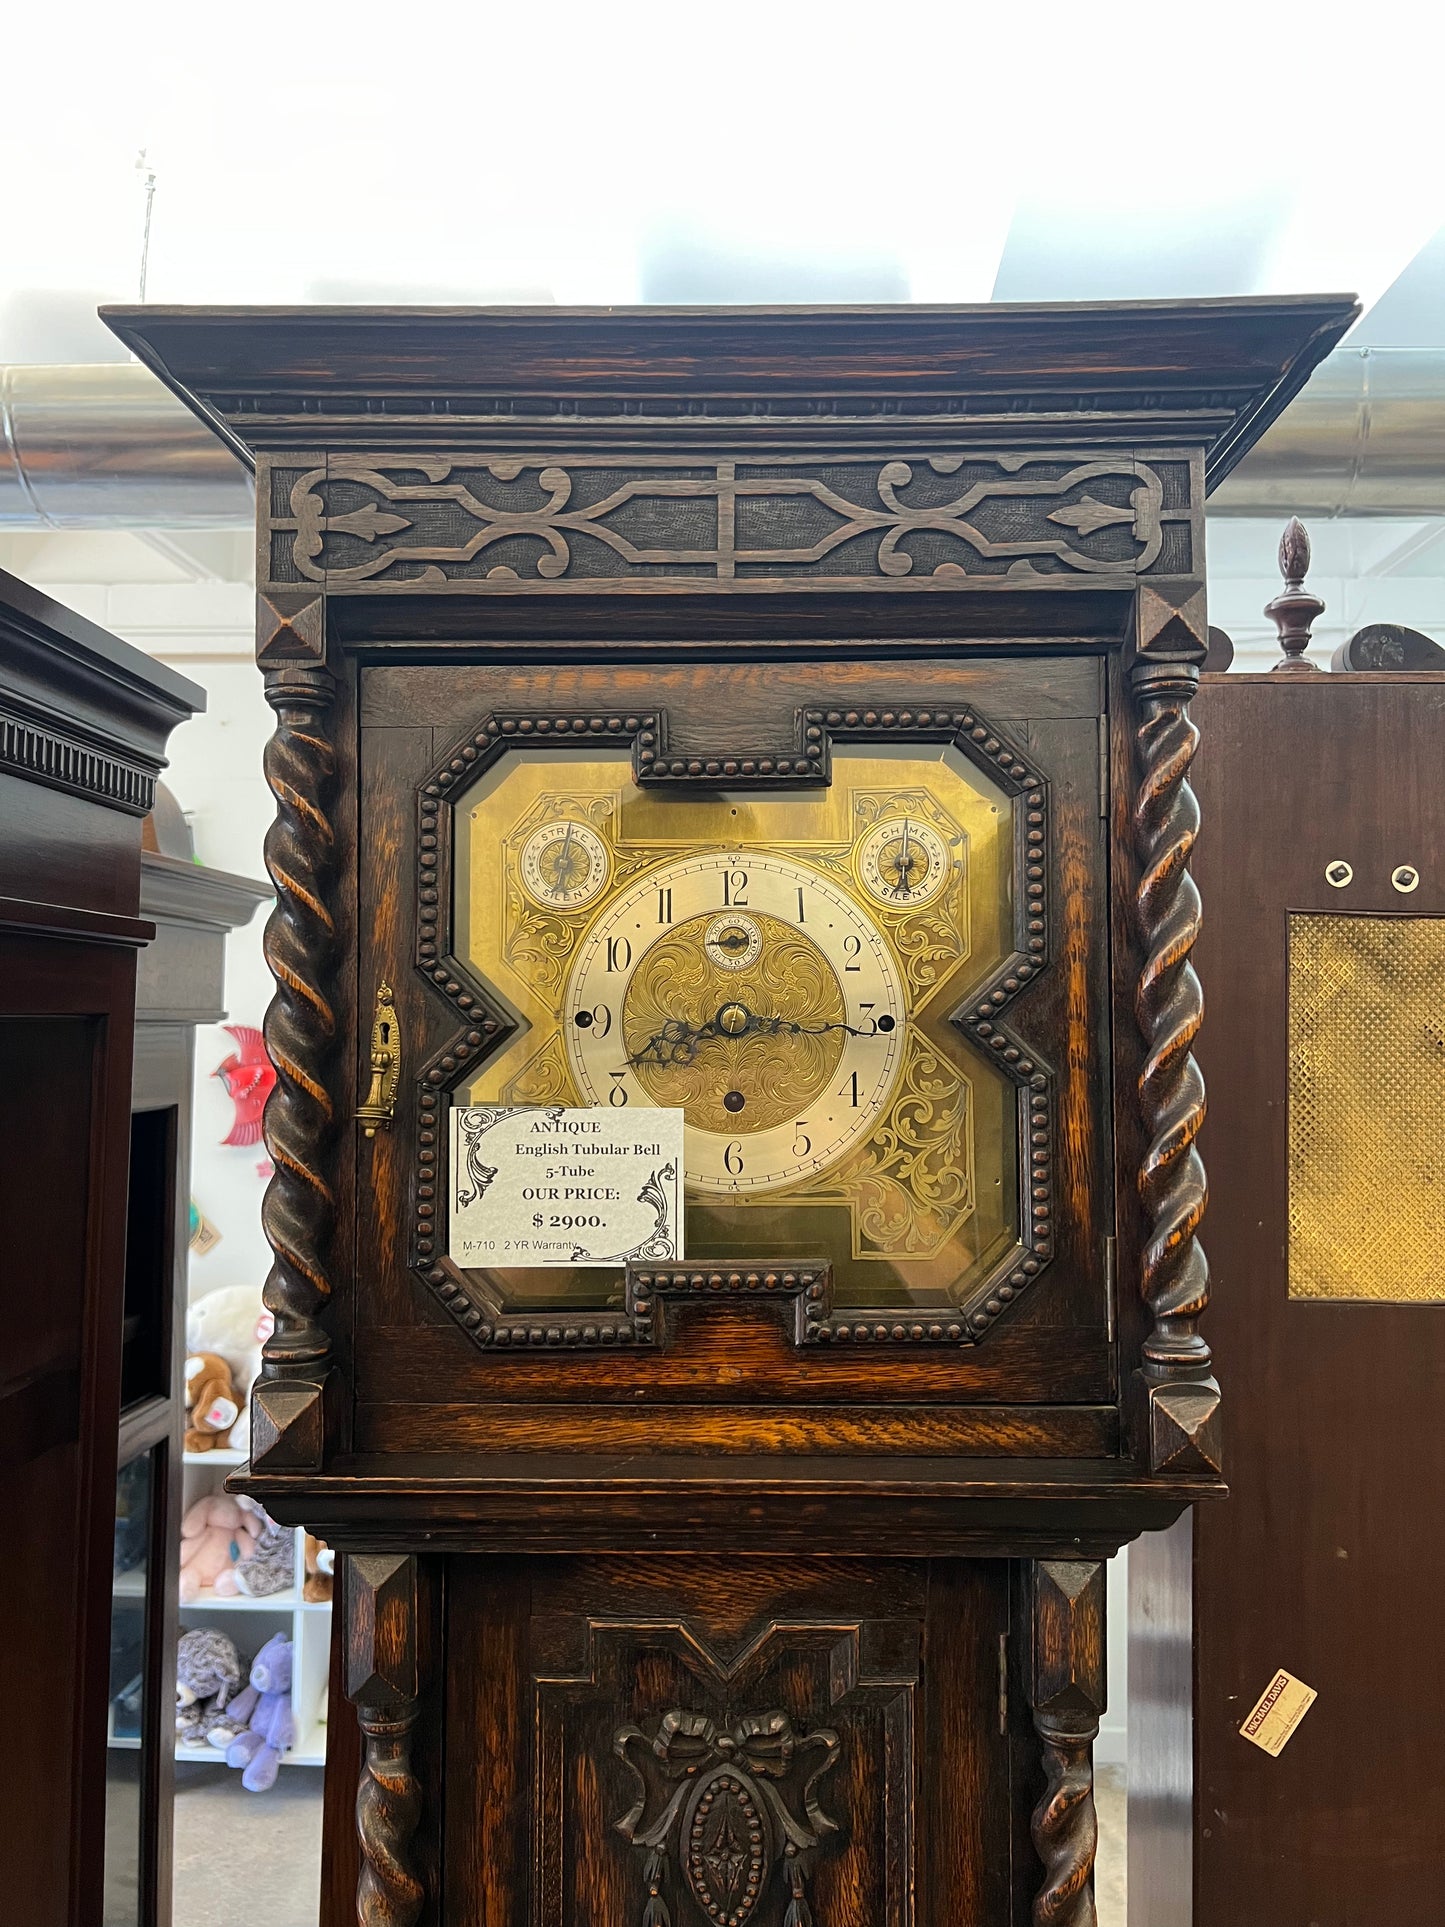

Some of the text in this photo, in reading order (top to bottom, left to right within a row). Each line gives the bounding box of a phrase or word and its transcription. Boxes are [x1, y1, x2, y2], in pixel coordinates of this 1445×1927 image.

[541, 827, 589, 843] STRKE
[881, 827, 928, 840] CHME
[542, 884, 591, 901] SILENT
[721, 870, 748, 906] 12
[794, 887, 808, 923] 1
[881, 883, 929, 901] SILENT
[656, 888, 673, 924] 11
[604, 936, 631, 972] 10
[843, 935, 861, 972] 2
[591, 1003, 612, 1039] 9
[858, 1003, 878, 1039] 3
[608, 1072, 628, 1107] 8
[837, 1071, 865, 1108] 4
[530, 1121, 601, 1134] ANTIQUE
[792, 1121, 812, 1157] 5
[515, 1143, 661, 1157] English Tubular Bell
[724, 1140, 744, 1175] 6
[546, 1165, 595, 1178] 5-Tube
[522, 1187, 620, 1200] OUR PRICE:
[532, 1212, 607, 1230] $ 2900.
[463, 1240, 577, 1252] M-710 2 YR Warranty
[1246, 1676, 1288, 1734] MICHAEL DAVIS
